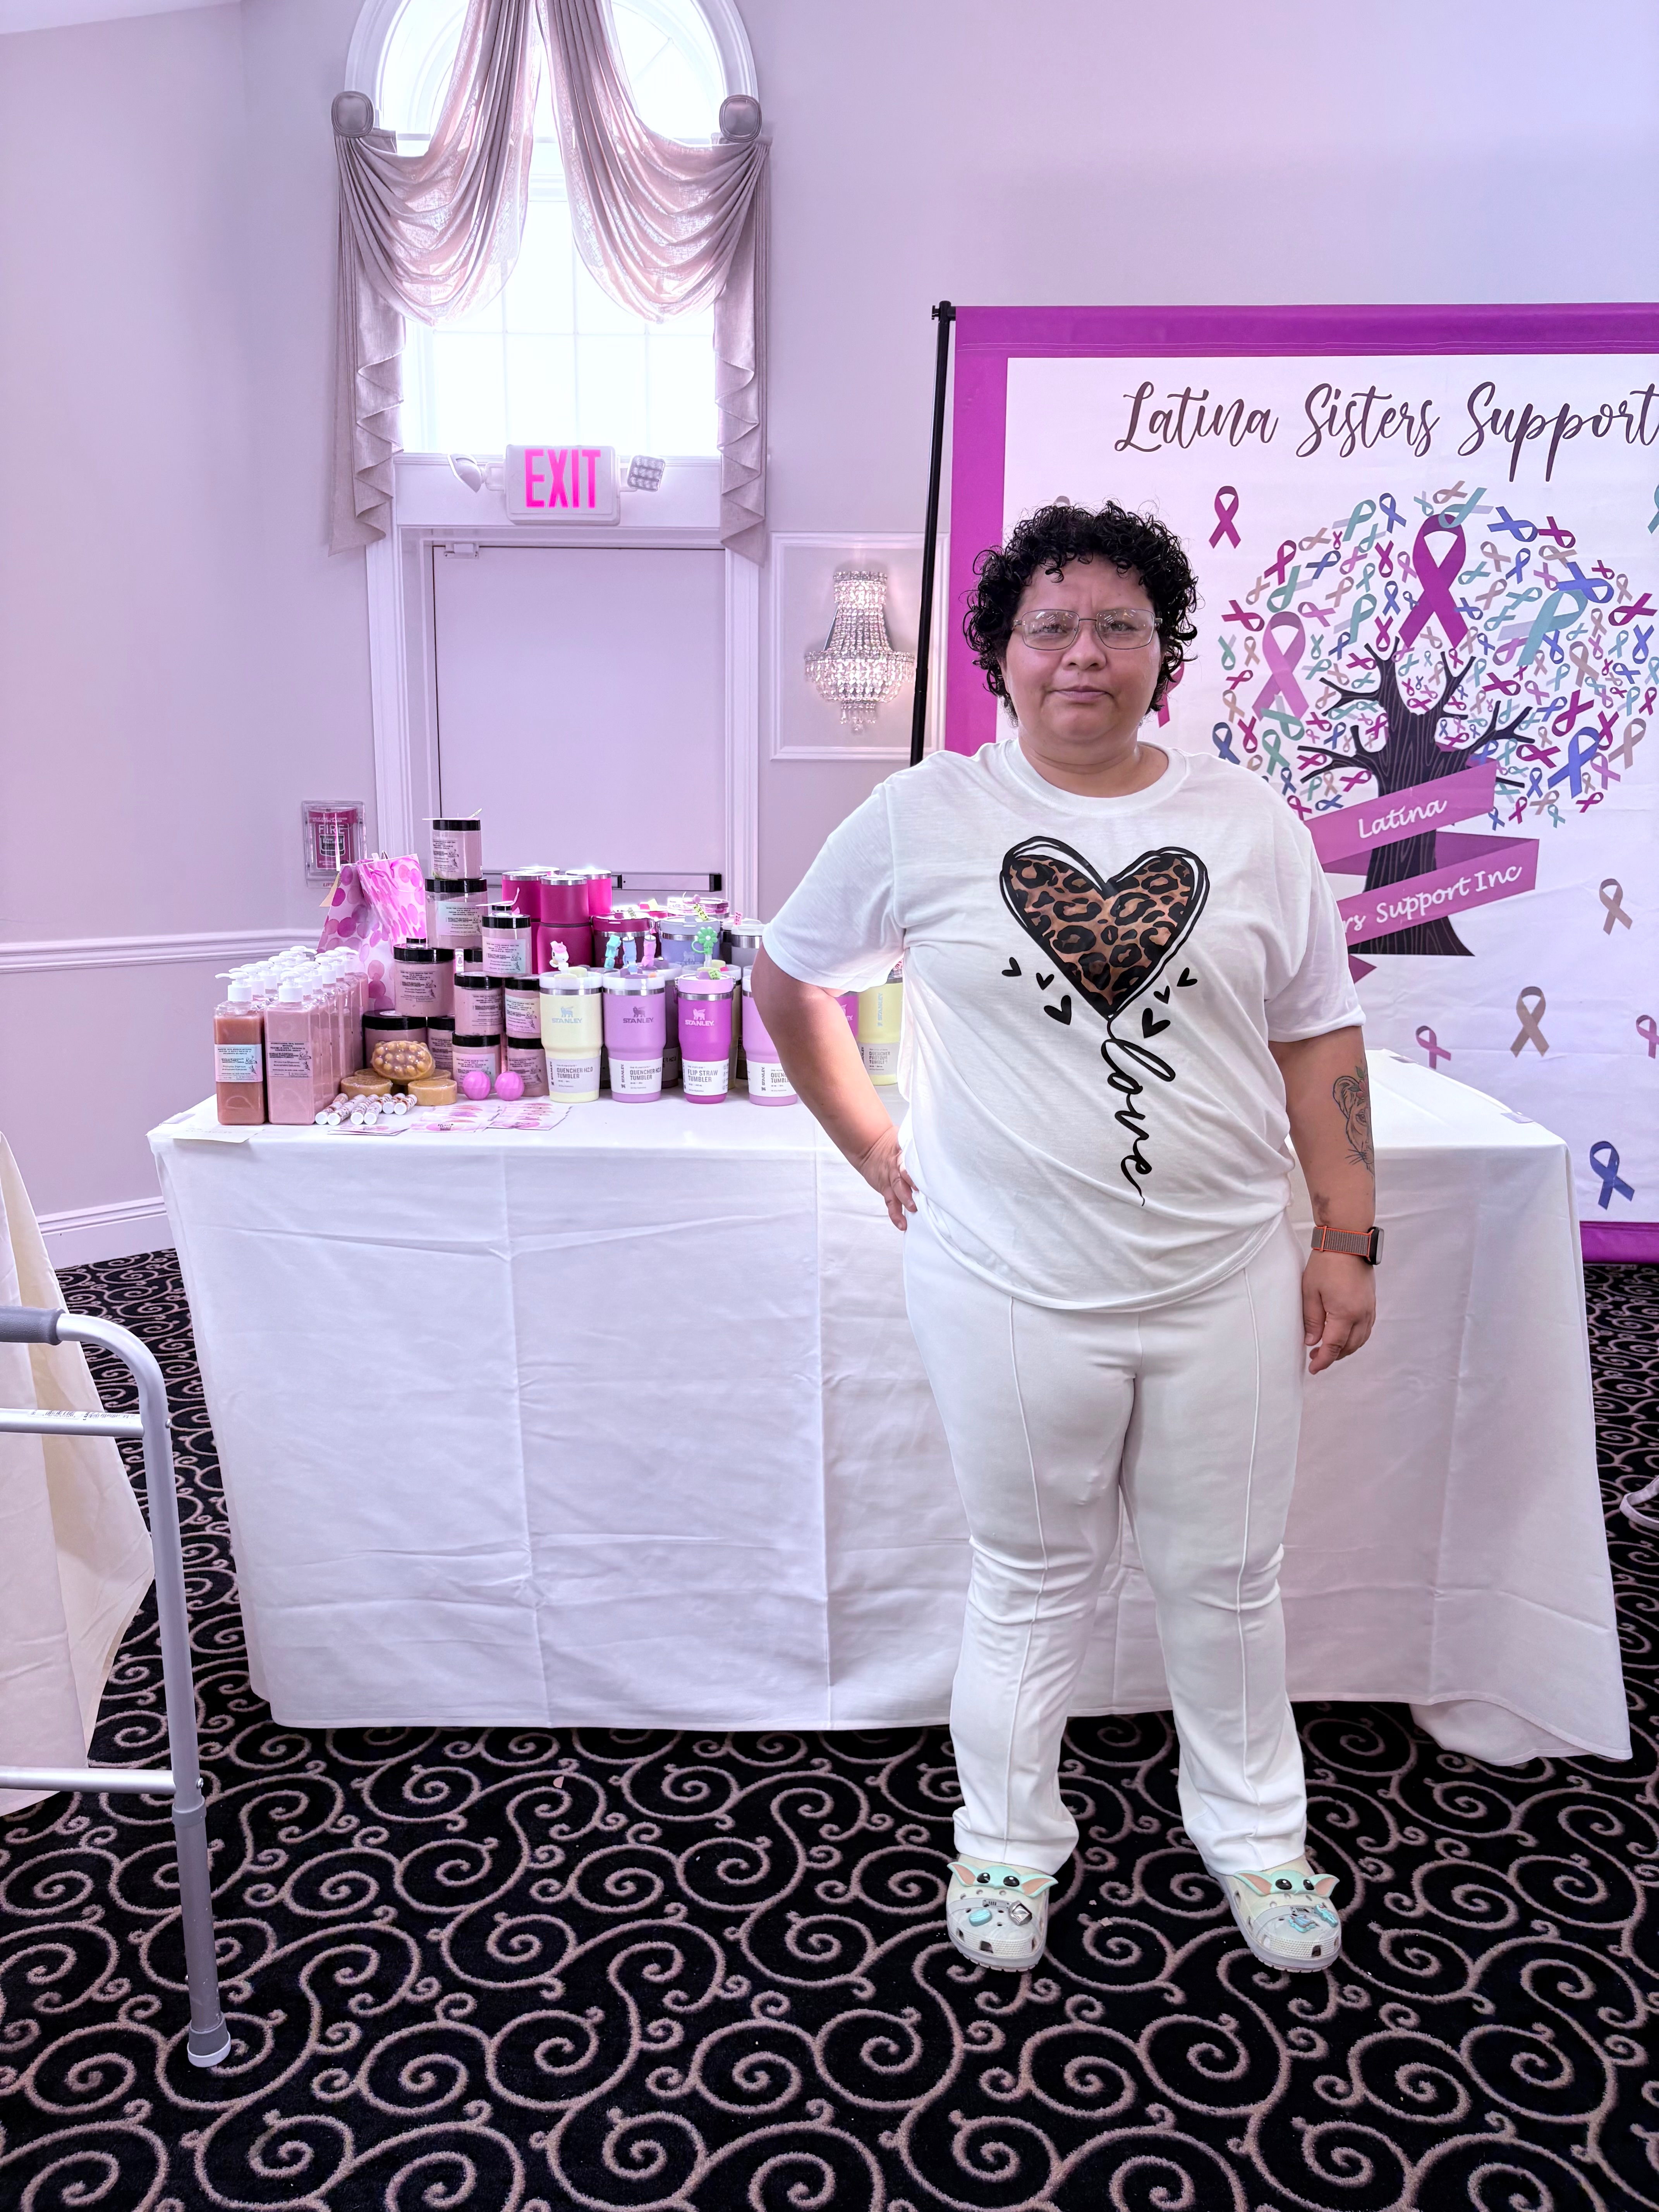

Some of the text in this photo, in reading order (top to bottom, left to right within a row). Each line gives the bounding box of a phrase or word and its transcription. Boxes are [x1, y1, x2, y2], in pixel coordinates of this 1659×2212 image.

[1114, 381, 1659, 483] Latina Sisters Support
[524, 449, 601, 509] EXIT
[319, 824, 345, 834] FIRE
[1358, 799, 1448, 839] Latina
[1376, 866, 1522, 923] Support Inc
[1101, 1038, 1176, 1206] love
